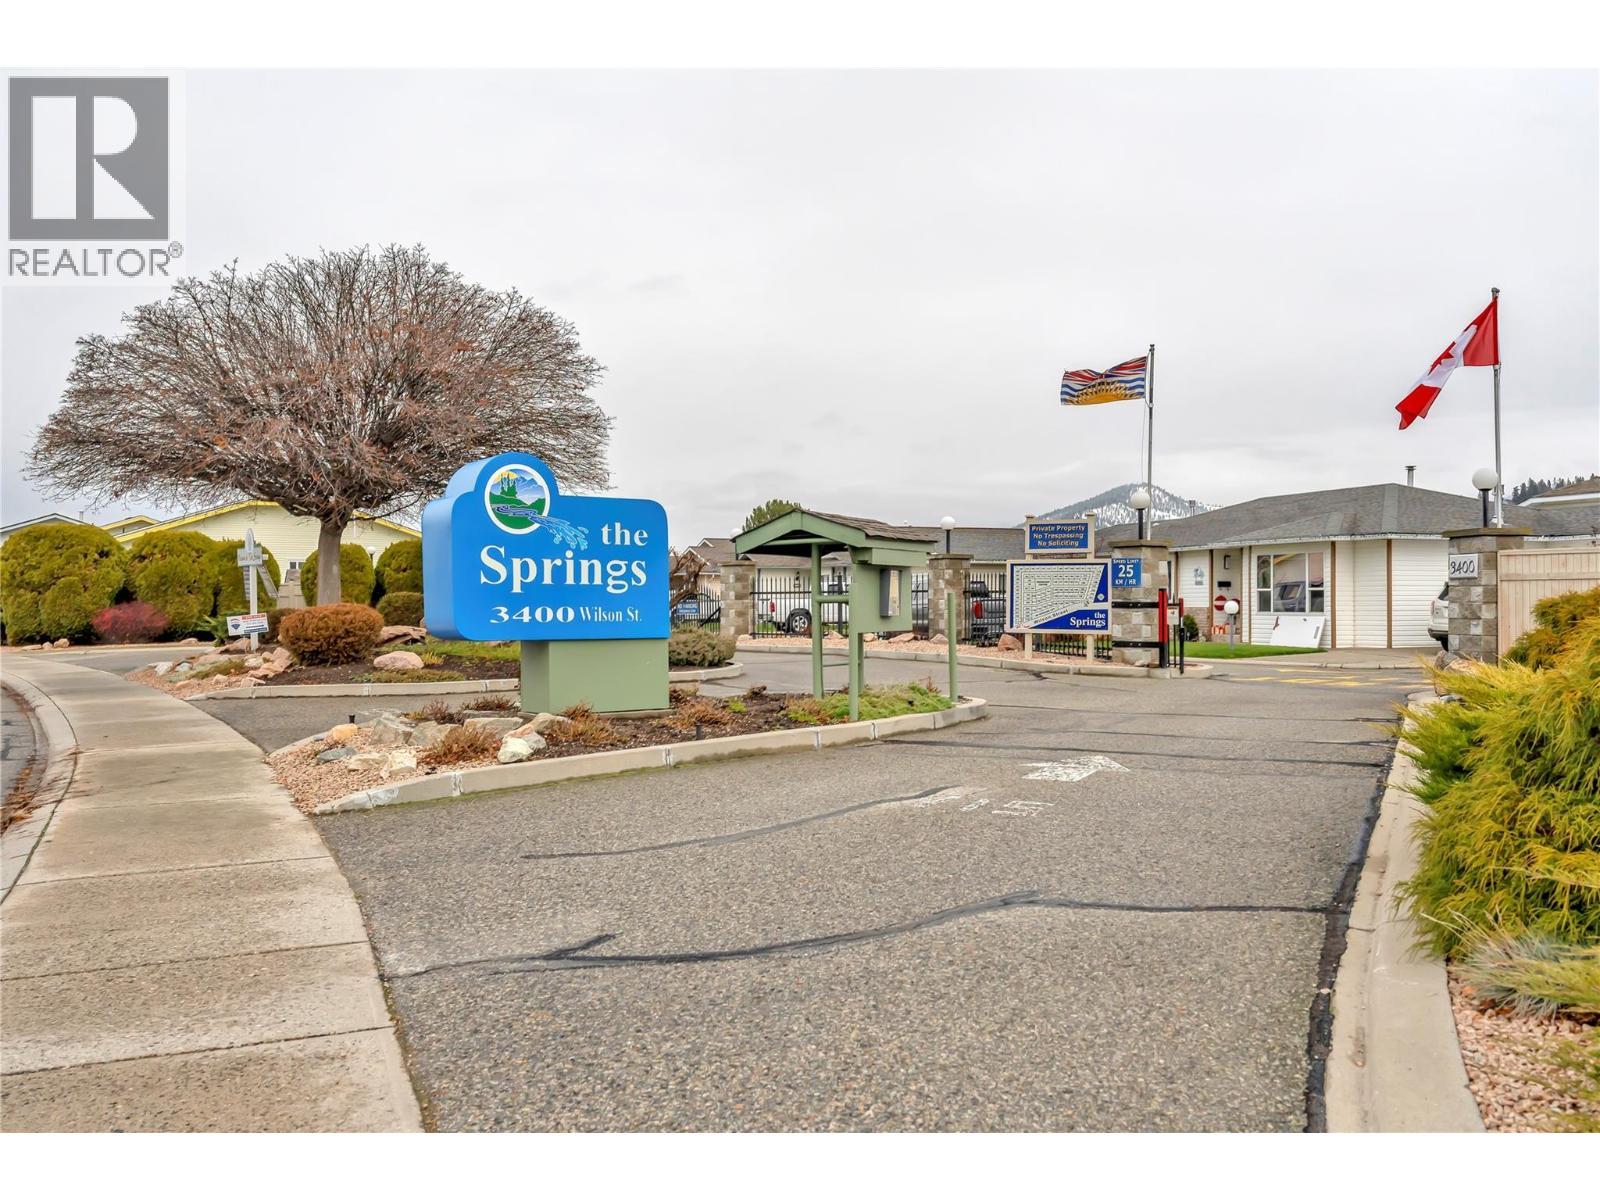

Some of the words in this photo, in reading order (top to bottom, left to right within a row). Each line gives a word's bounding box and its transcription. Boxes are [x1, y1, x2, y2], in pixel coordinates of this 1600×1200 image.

[600, 522, 649, 546] the
[479, 545, 647, 594] Springs
[1118, 564, 1134, 578] 25
[1450, 560, 1475, 574] 3400
[489, 606, 575, 624] 3400
[580, 606, 622, 622] Wilson
[626, 606, 643, 622] St.
[1070, 616, 1106, 628] Springs
